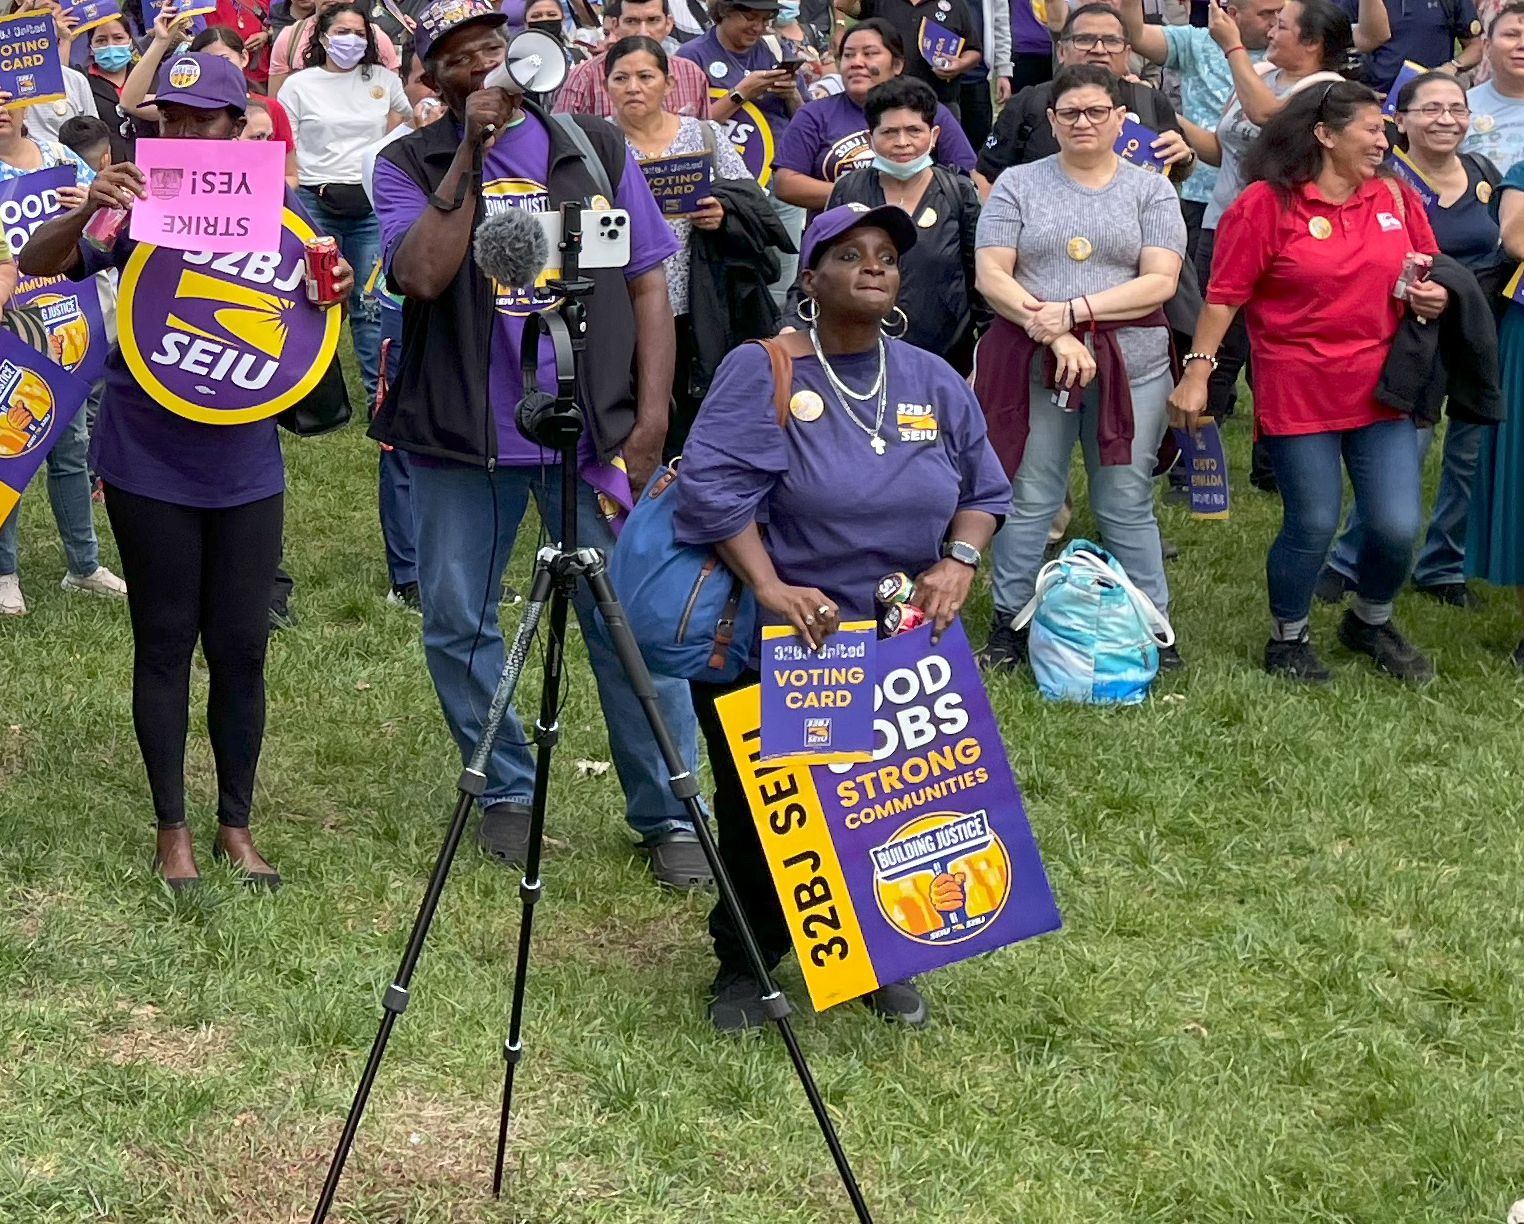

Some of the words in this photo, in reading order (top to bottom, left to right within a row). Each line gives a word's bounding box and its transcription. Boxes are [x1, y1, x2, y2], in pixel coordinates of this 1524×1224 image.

[0, 53, 44, 73] CARD
[834, 137, 862, 158] 32BJ
[1121, 138, 1140, 158] TO
[190, 169, 253, 196] YES!
[652, 183, 695, 196] CARD
[0, 189, 62, 225] OOD
[161, 213, 252, 237] STRIKE
[48, 299, 77, 320] JUSTICE
[150, 332, 280, 390] SEIU
[897, 403, 933, 416] 32BJ
[900, 430, 938, 442] SEIU
[773, 666, 865, 688] VOTING
[875, 654, 953, 713] OD
[785, 689, 853, 710] CARD
[836, 736, 983, 808] STRONG
[844, 766, 990, 832] COMMUNITIES
[877, 834, 937, 870] BUILDING
[935, 817, 985, 850] JUSTICE
[783, 850, 850, 968] 32BJ
